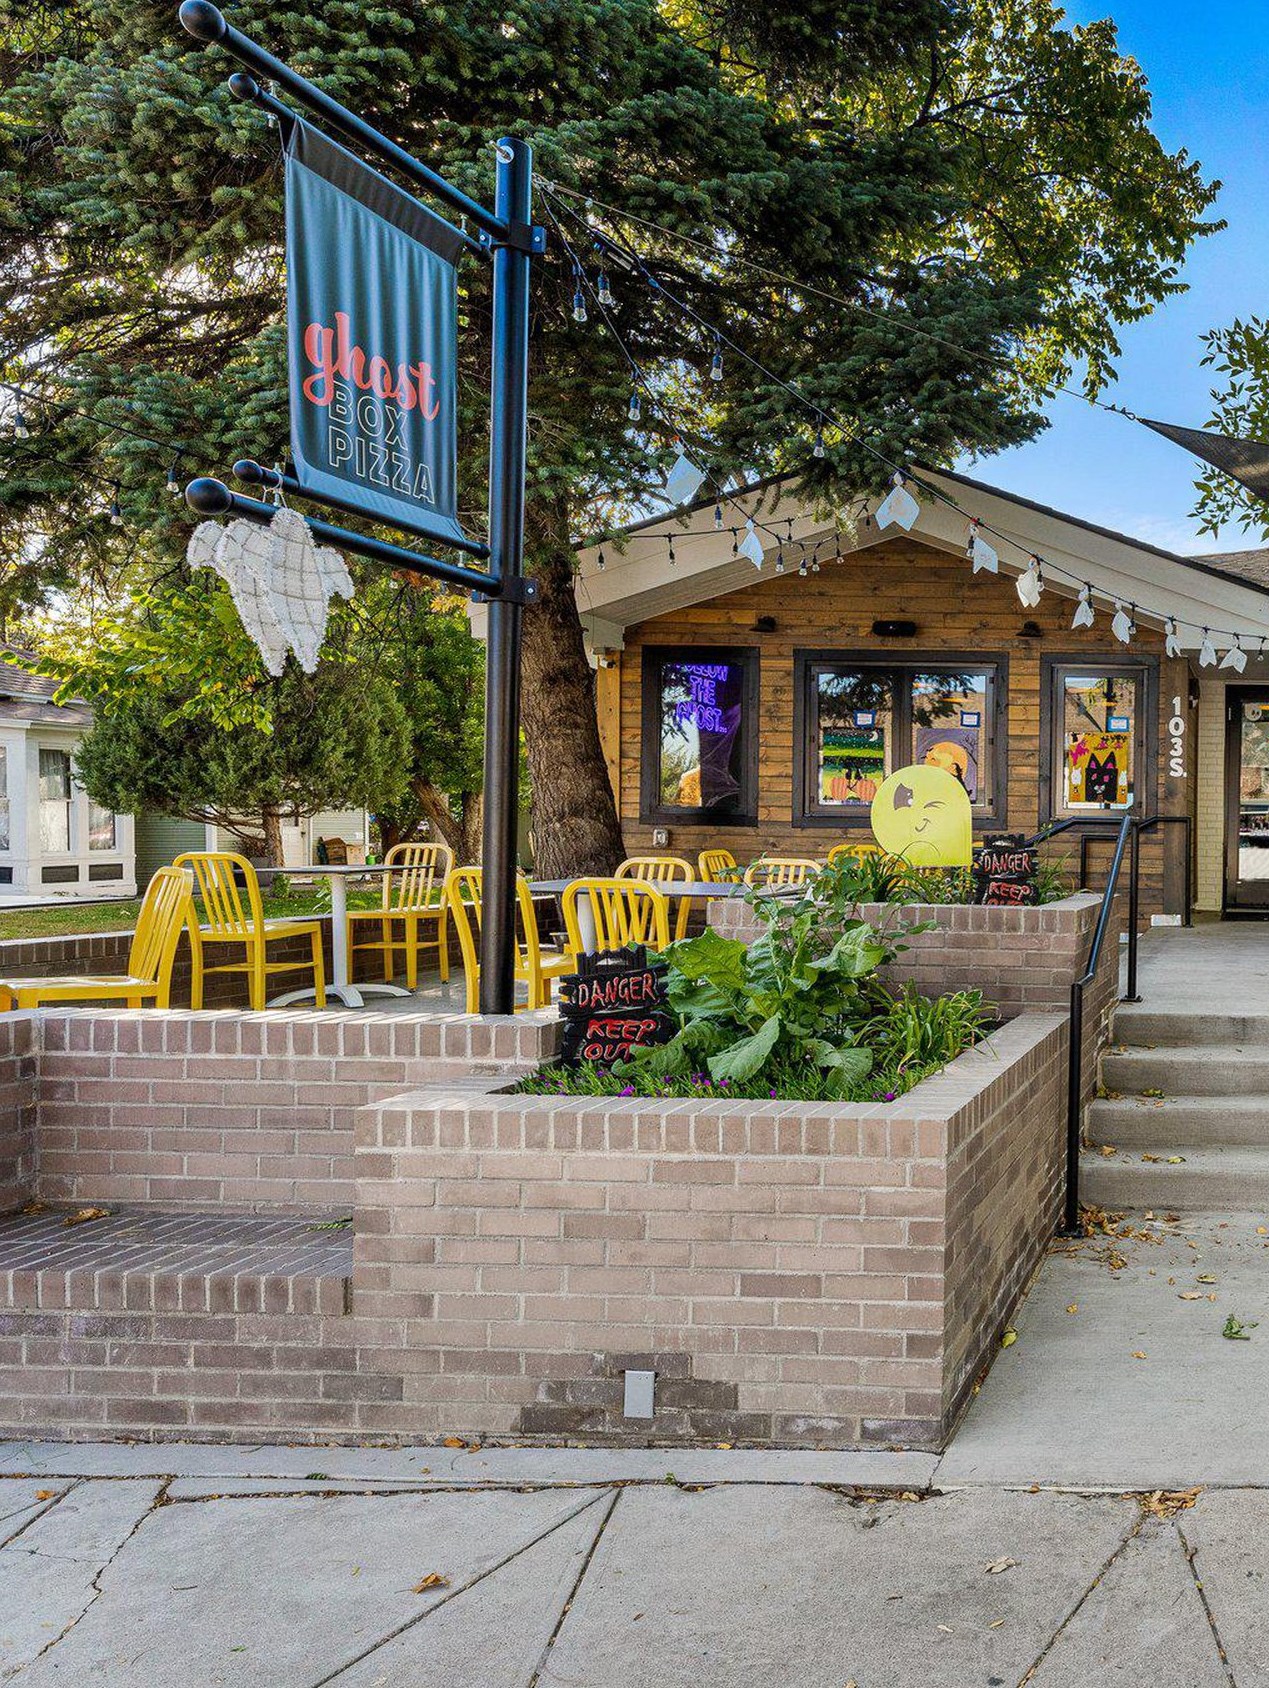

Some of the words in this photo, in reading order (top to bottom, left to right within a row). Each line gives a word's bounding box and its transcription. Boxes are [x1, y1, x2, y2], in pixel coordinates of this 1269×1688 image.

[303, 311, 440, 422] ghost
[328, 380, 409, 451] BOX
[328, 425, 436, 505] PIZZA
[689, 675, 716, 706] THE
[983, 852, 1032, 873] DANGER
[988, 881, 1031, 900] KEEP
[578, 972, 657, 1008] DANGER
[586, 1018, 658, 1041] KEEP
